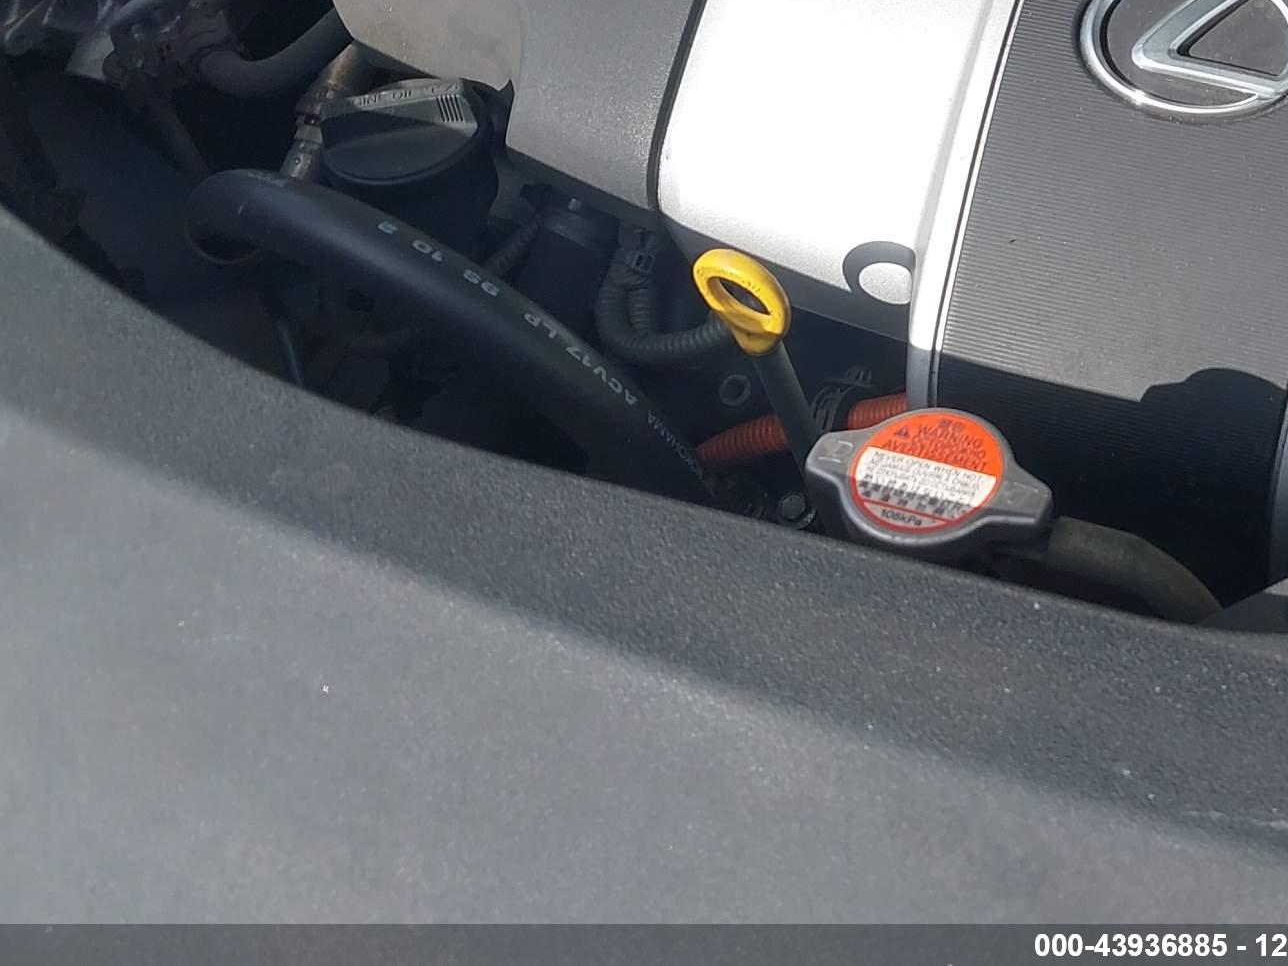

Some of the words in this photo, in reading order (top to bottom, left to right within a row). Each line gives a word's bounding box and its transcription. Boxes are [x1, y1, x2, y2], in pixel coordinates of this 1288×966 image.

[525, 314, 557, 338] LP
[566, 347, 637, 405] ACV17
[918, 424, 983, 448] WARNING
[880, 508, 923, 526] 108kPa
